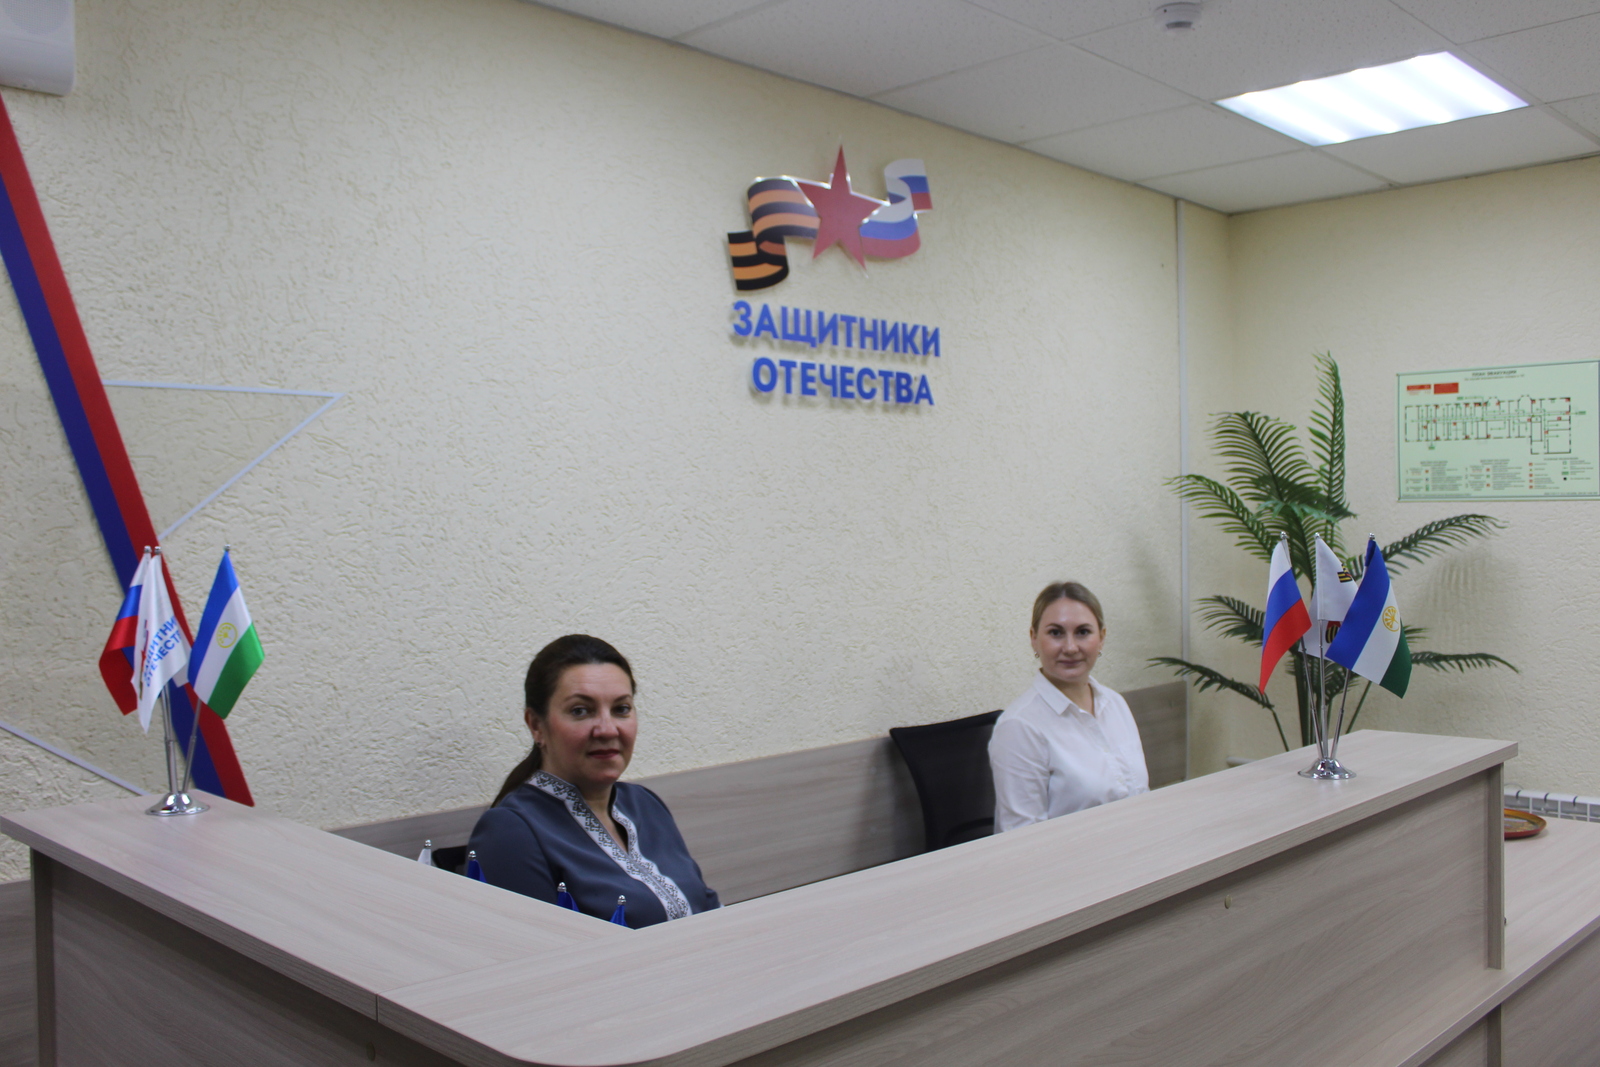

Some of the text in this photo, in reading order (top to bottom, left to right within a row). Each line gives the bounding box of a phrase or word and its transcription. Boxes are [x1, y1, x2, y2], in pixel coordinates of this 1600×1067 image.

[733, 300, 941, 358] ЗАЩИТНИКИ
[752, 357, 935, 406] ОТЕЧЕСТВА
[145, 630, 181, 688] ОТЕЧЕСТ
